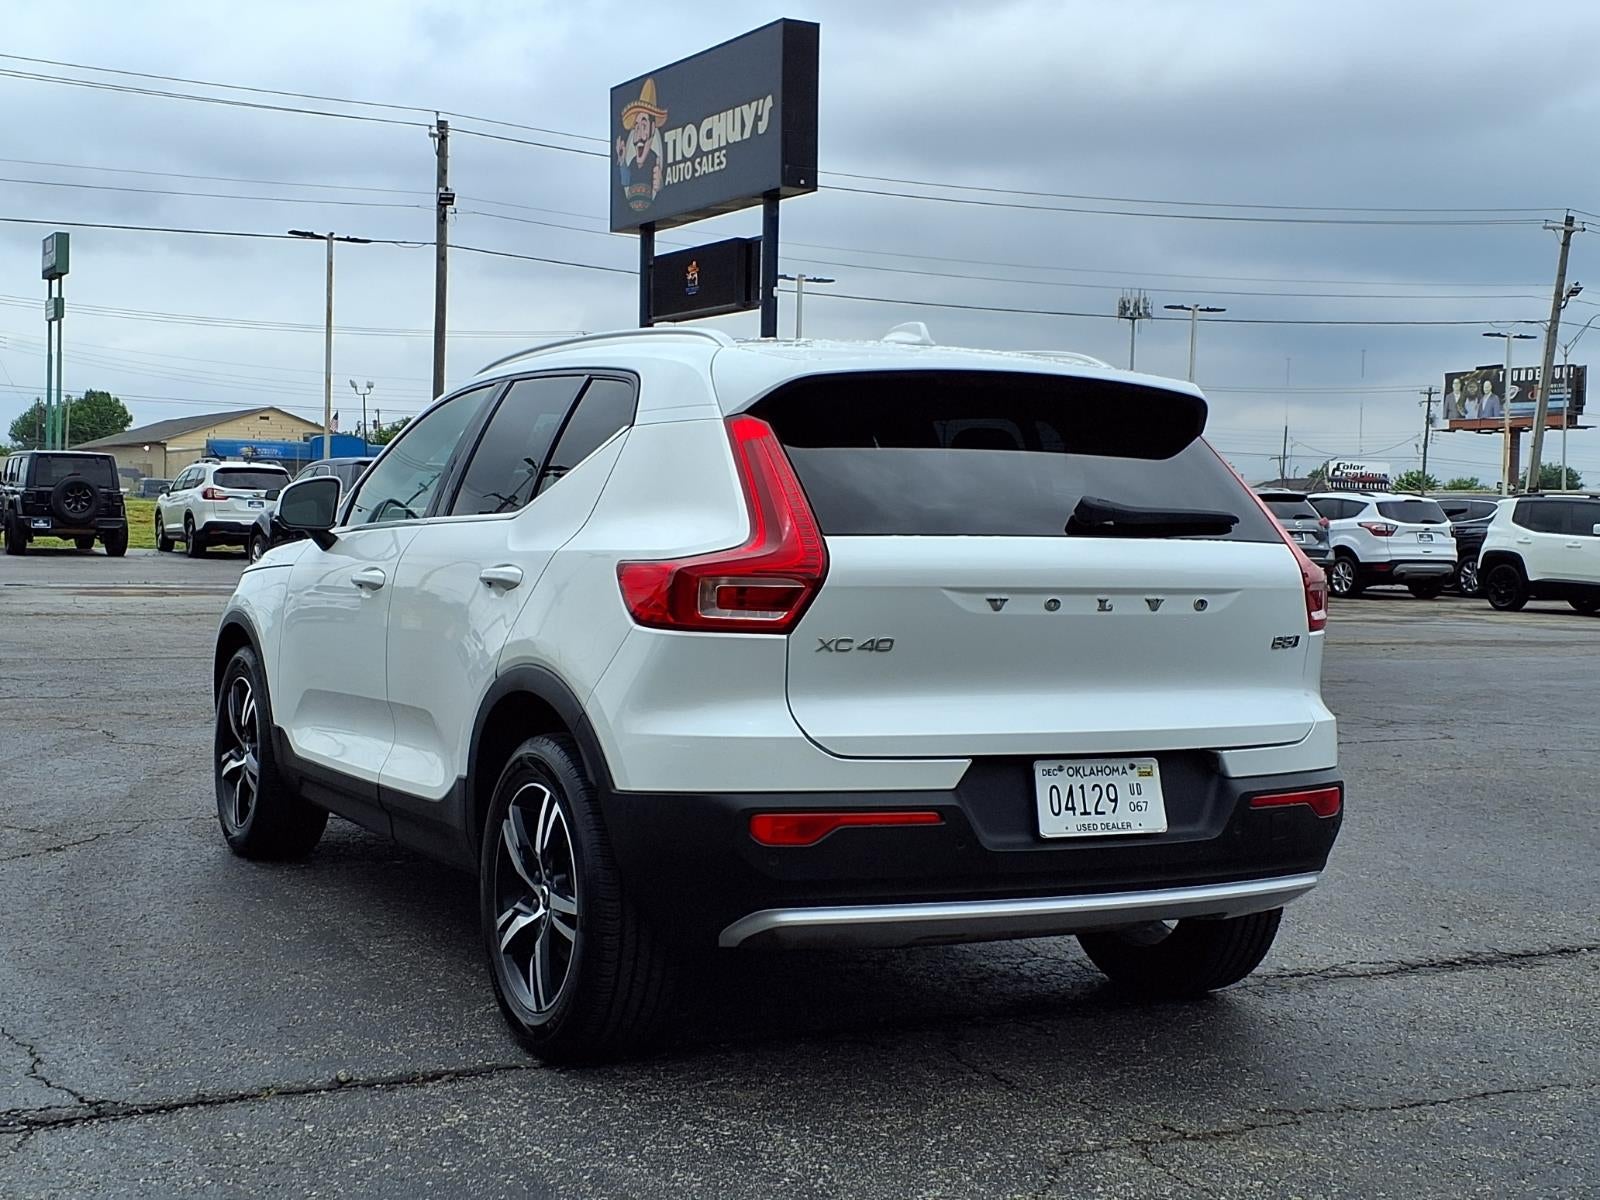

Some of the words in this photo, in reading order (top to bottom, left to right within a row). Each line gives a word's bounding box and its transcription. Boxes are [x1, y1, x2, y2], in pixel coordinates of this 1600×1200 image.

[664, 123, 698, 164] TIO
[700, 94, 773, 152] CHUY'S
[665, 161, 692, 186] AUTO
[694, 149, 727, 177] SALES
[1499, 368, 1546, 382] TUNDE
[1331, 467, 1388, 478] Creations
[1336, 462, 1366, 470] Color
[985, 598, 1209, 612] VOLVO
[1042, 768, 1058, 776] DEC
[1066, 765, 1128, 779] OKLAHOMA
[1049, 783, 1118, 816] 04129
[1129, 801, 1149, 812] 067
[1076, 822, 1098, 831] USED
[1100, 821, 1132, 830] DEALER
